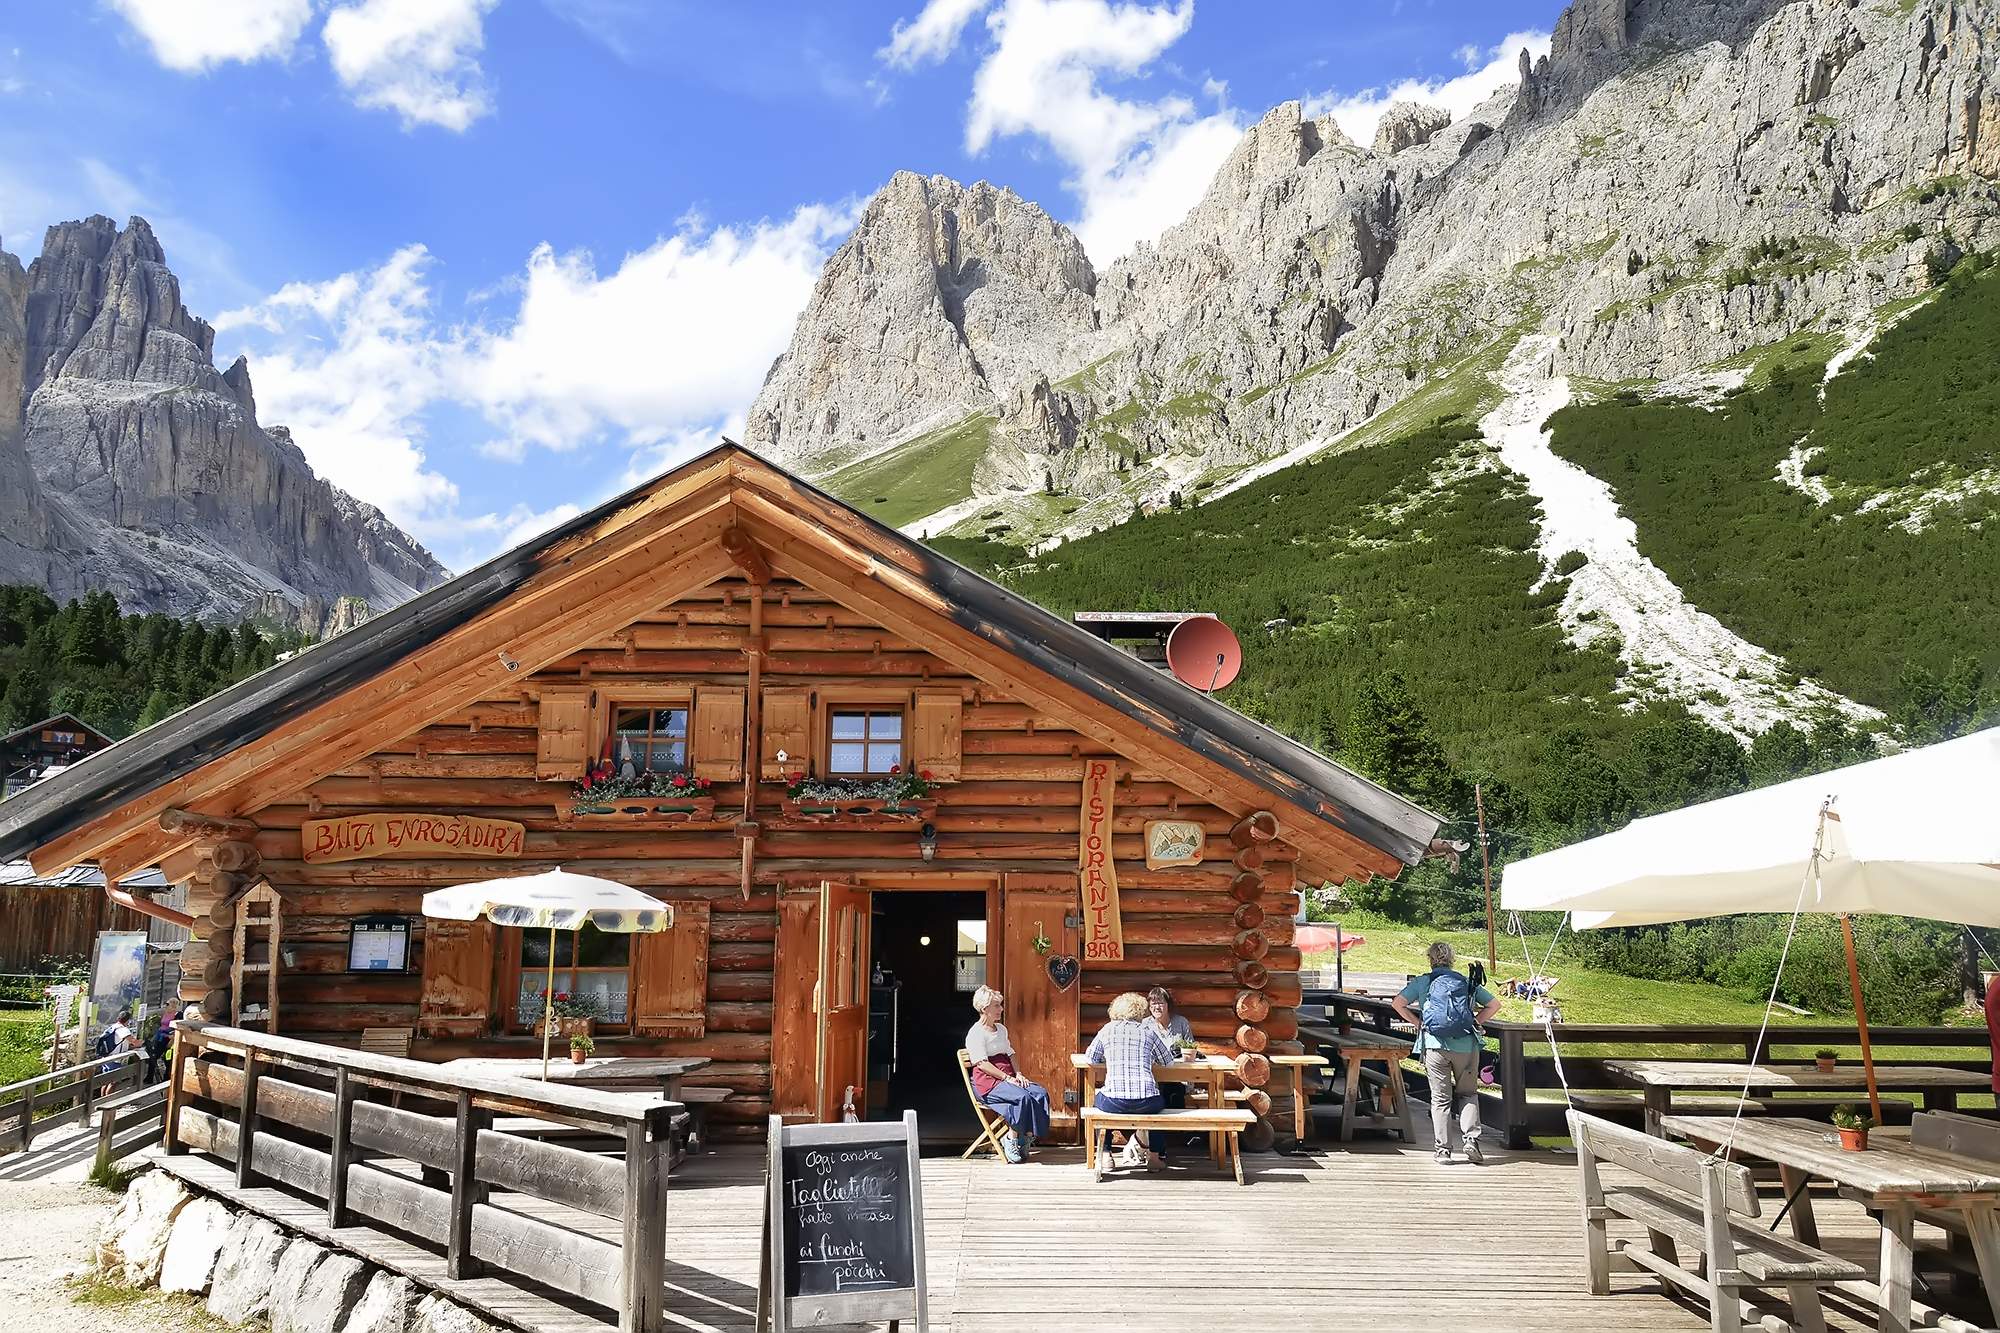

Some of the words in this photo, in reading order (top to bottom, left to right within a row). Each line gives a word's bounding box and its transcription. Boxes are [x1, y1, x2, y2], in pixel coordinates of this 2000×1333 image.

[1086, 942, 1121, 959] BAR
[805, 1150, 835, 1175] Oggi
[840, 1149, 883, 1162] anche
[800, 1241, 813, 1257] ai
[818, 1232, 864, 1267] funghi
